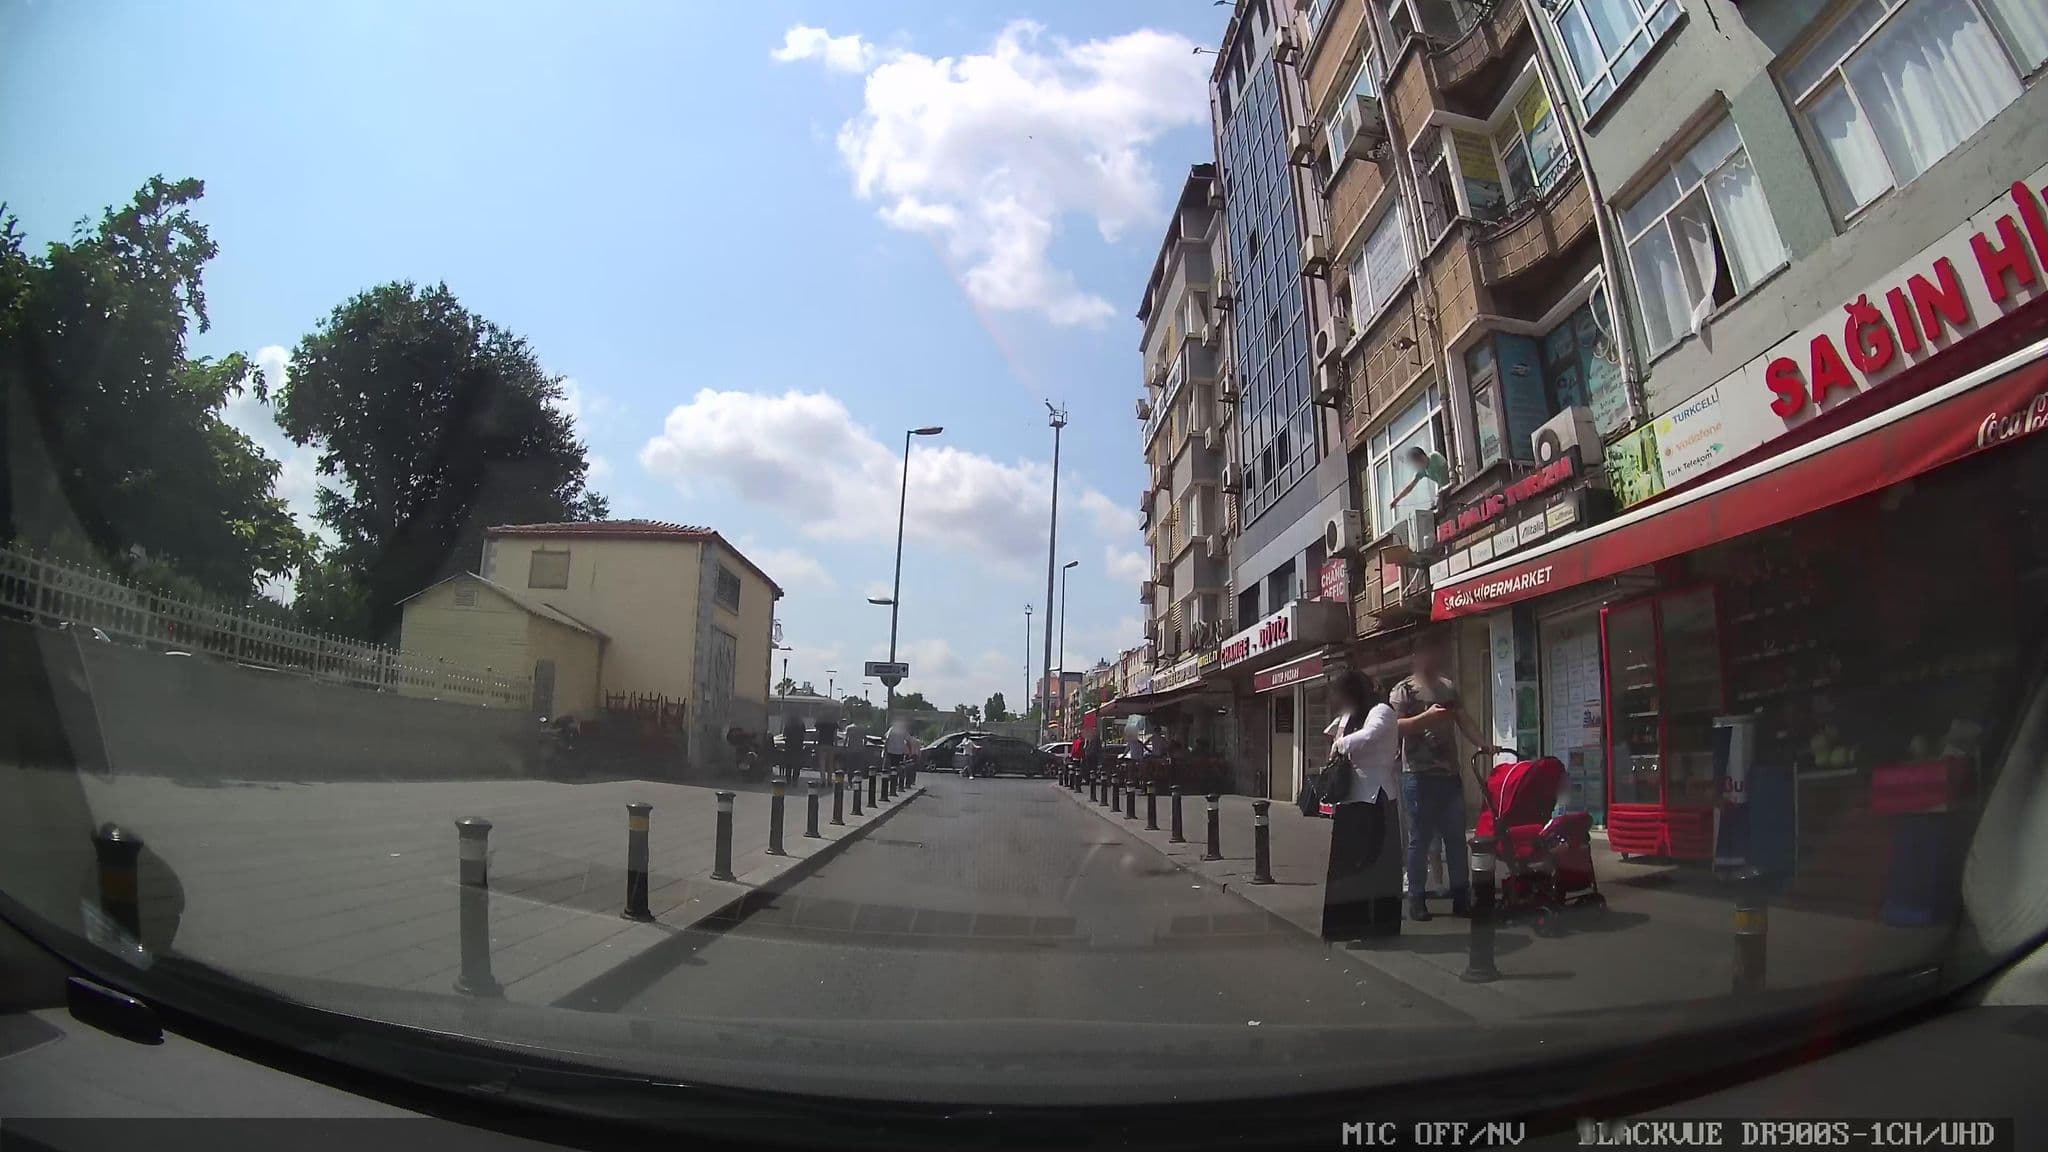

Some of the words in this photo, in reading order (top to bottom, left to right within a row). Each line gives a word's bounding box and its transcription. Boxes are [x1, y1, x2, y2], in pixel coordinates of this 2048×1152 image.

[1765, 256, 1969, 418] SAĞIN
[1969, 180, 2048, 304] Hİ
[1672, 389, 1719, 424] TURKCELL
[1683, 451, 1713, 469] Telekom
[1444, 588, 1474, 610] SAĞIN
[1474, 566, 1552, 602] HİPERMARKET
[1221, 637, 1249, 664] CHANGE
[1259, 616, 1288, 649] DÖVİZ
